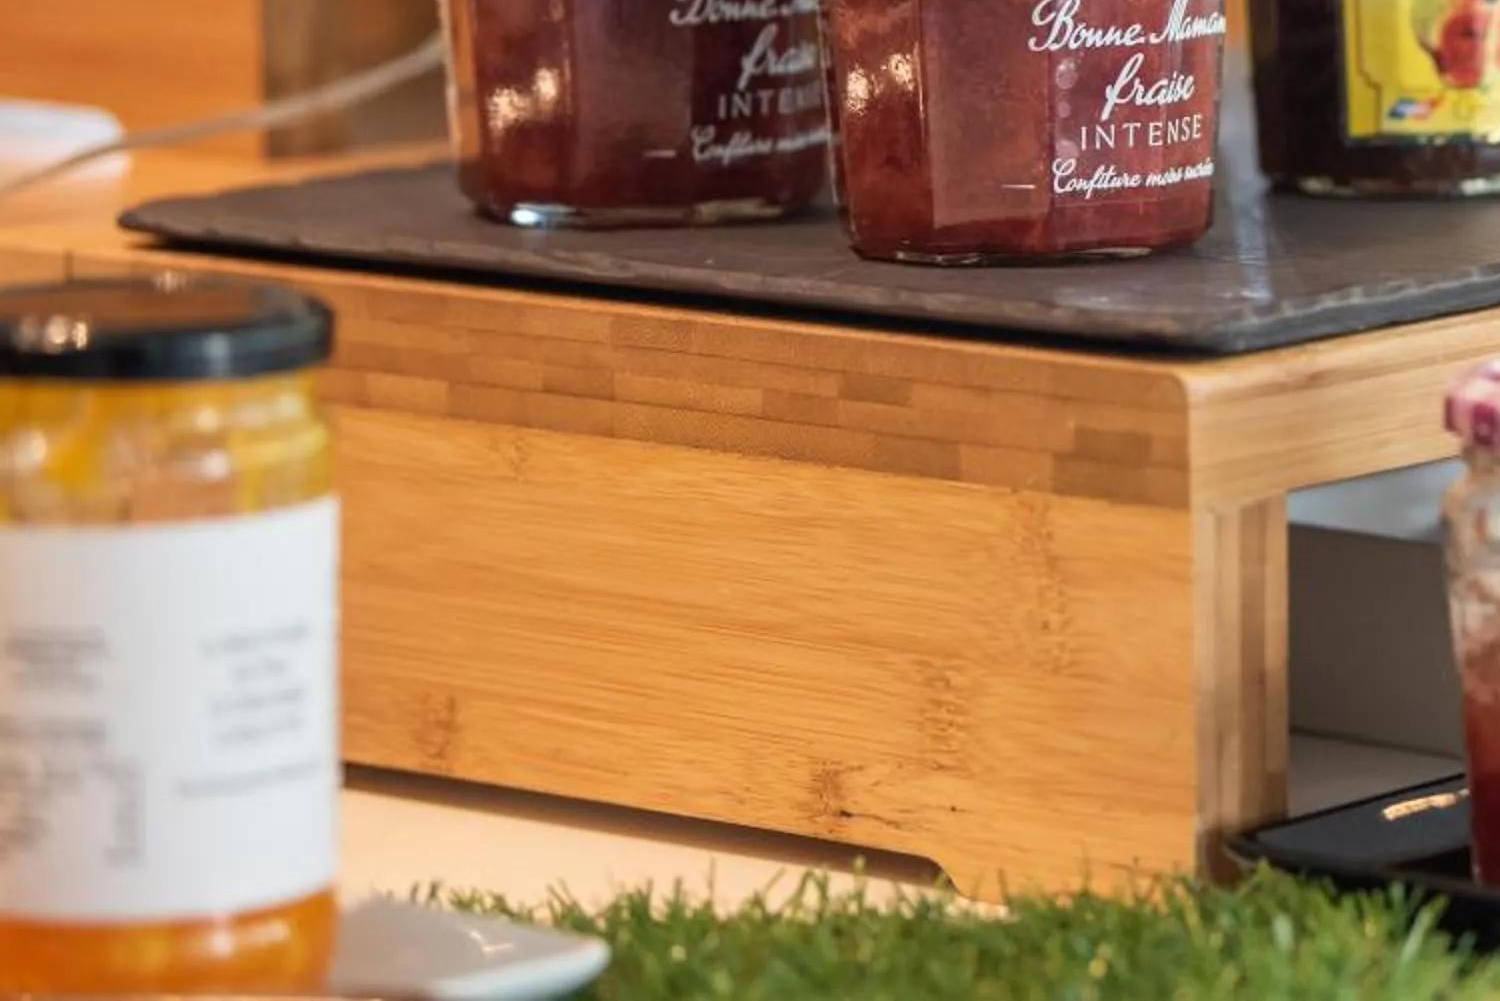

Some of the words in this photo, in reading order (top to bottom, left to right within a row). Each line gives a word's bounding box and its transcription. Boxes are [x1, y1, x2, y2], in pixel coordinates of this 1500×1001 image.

[1101, 52, 1196, 122] fraise
[1080, 113, 1204, 151] INTENSE
[1052, 158, 1141, 200] Confiture
